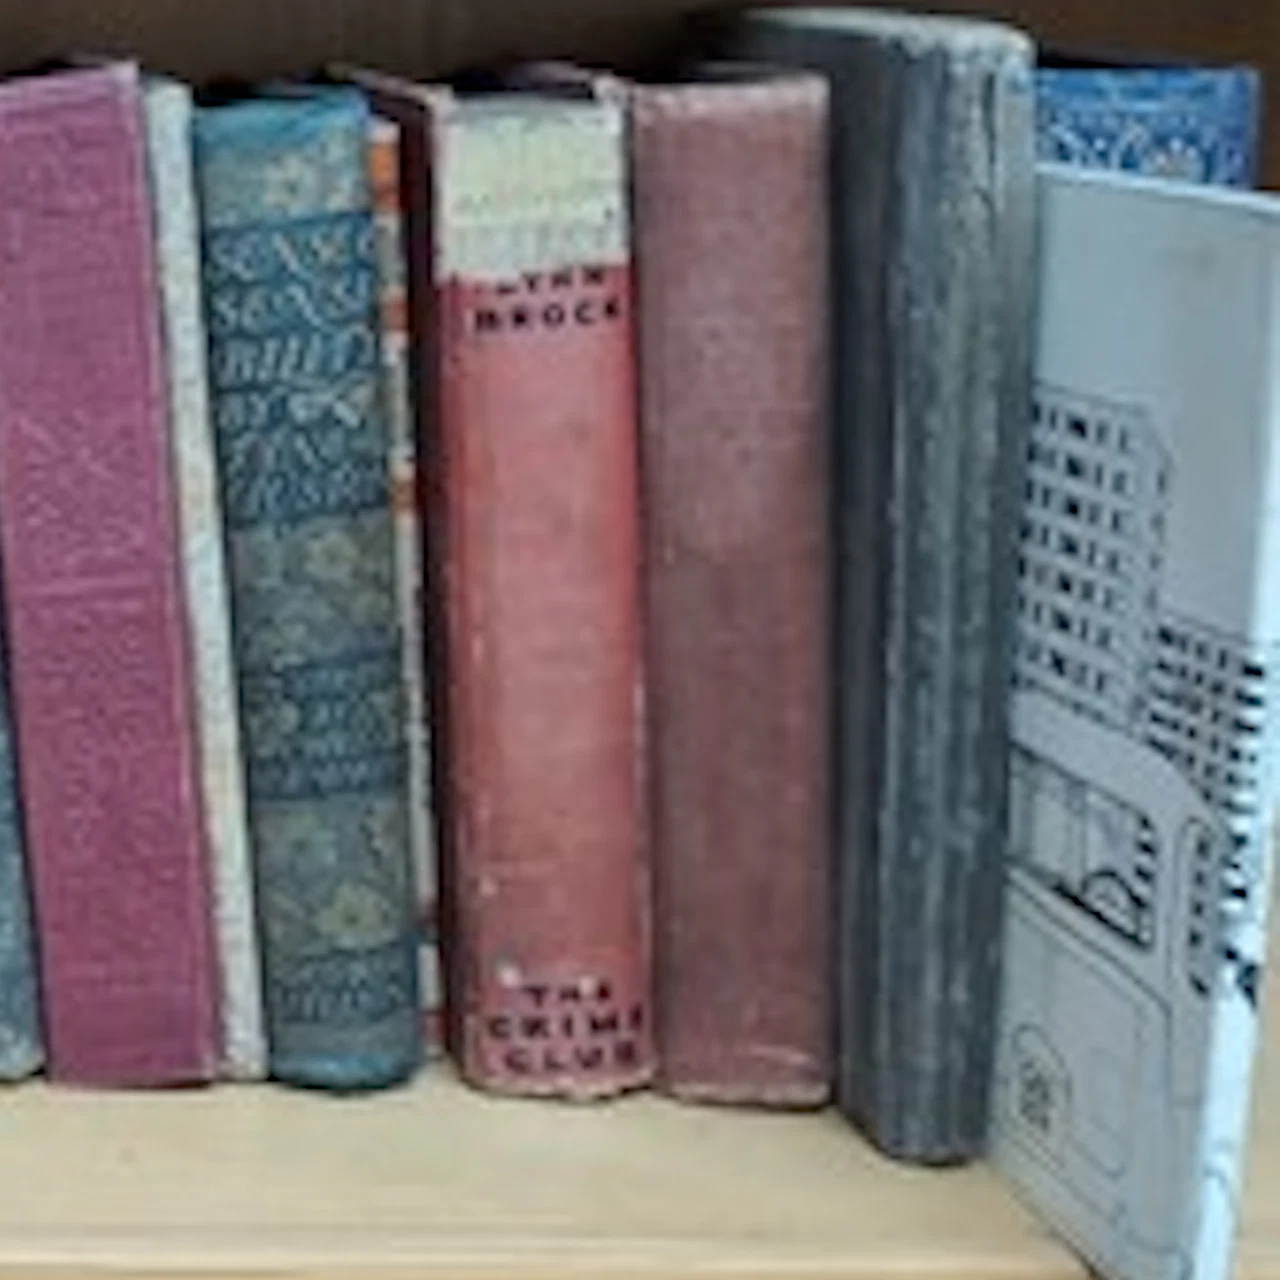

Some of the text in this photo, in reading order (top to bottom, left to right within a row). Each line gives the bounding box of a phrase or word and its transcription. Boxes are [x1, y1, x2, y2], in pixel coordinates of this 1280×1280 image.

[472, 297, 621, 335] BROCK
[489, 1001, 643, 1039] CRIME
[504, 1041, 635, 1075] CLUB
